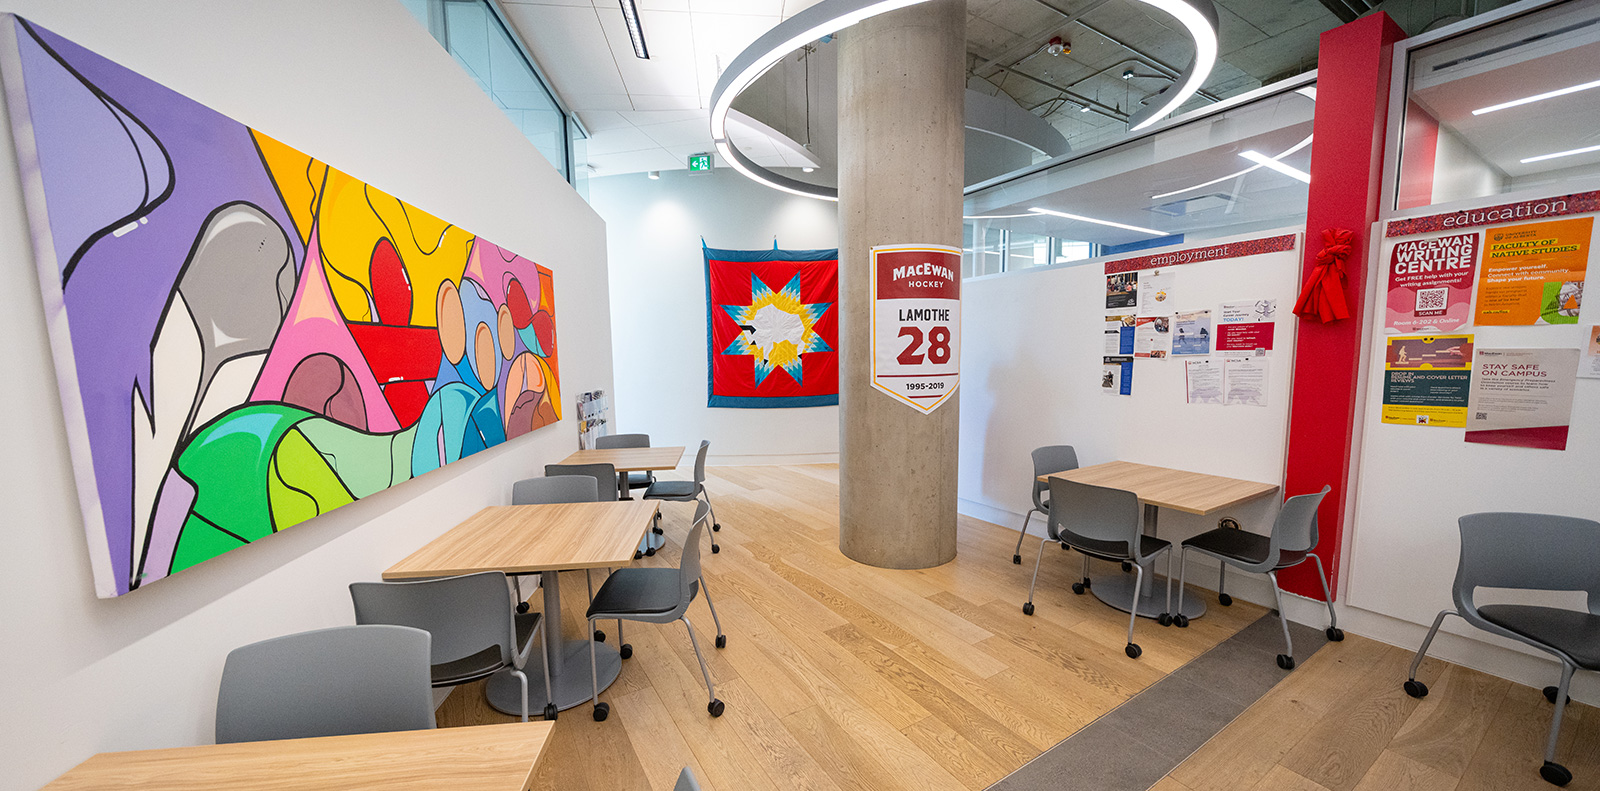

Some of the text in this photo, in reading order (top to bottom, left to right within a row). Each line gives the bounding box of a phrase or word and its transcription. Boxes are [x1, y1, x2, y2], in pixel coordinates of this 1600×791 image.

[1443, 200, 1568, 227] education
[1398, 234, 1474, 252] MACEWAN
[1491, 245, 1578, 258] NATIVE STUDIES
[1493, 240, 1540, 250] FACULTY
[1150, 247, 1229, 266] employment
[1397, 244, 1473, 262] WRITING
[1395, 255, 1472, 274] CENTRE
[1422, 278, 1462, 286] assignments!
[899, 309, 950, 321] LAMOTHE
[896, 326, 951, 365] 28
[905, 382, 945, 390] 1995-2019
